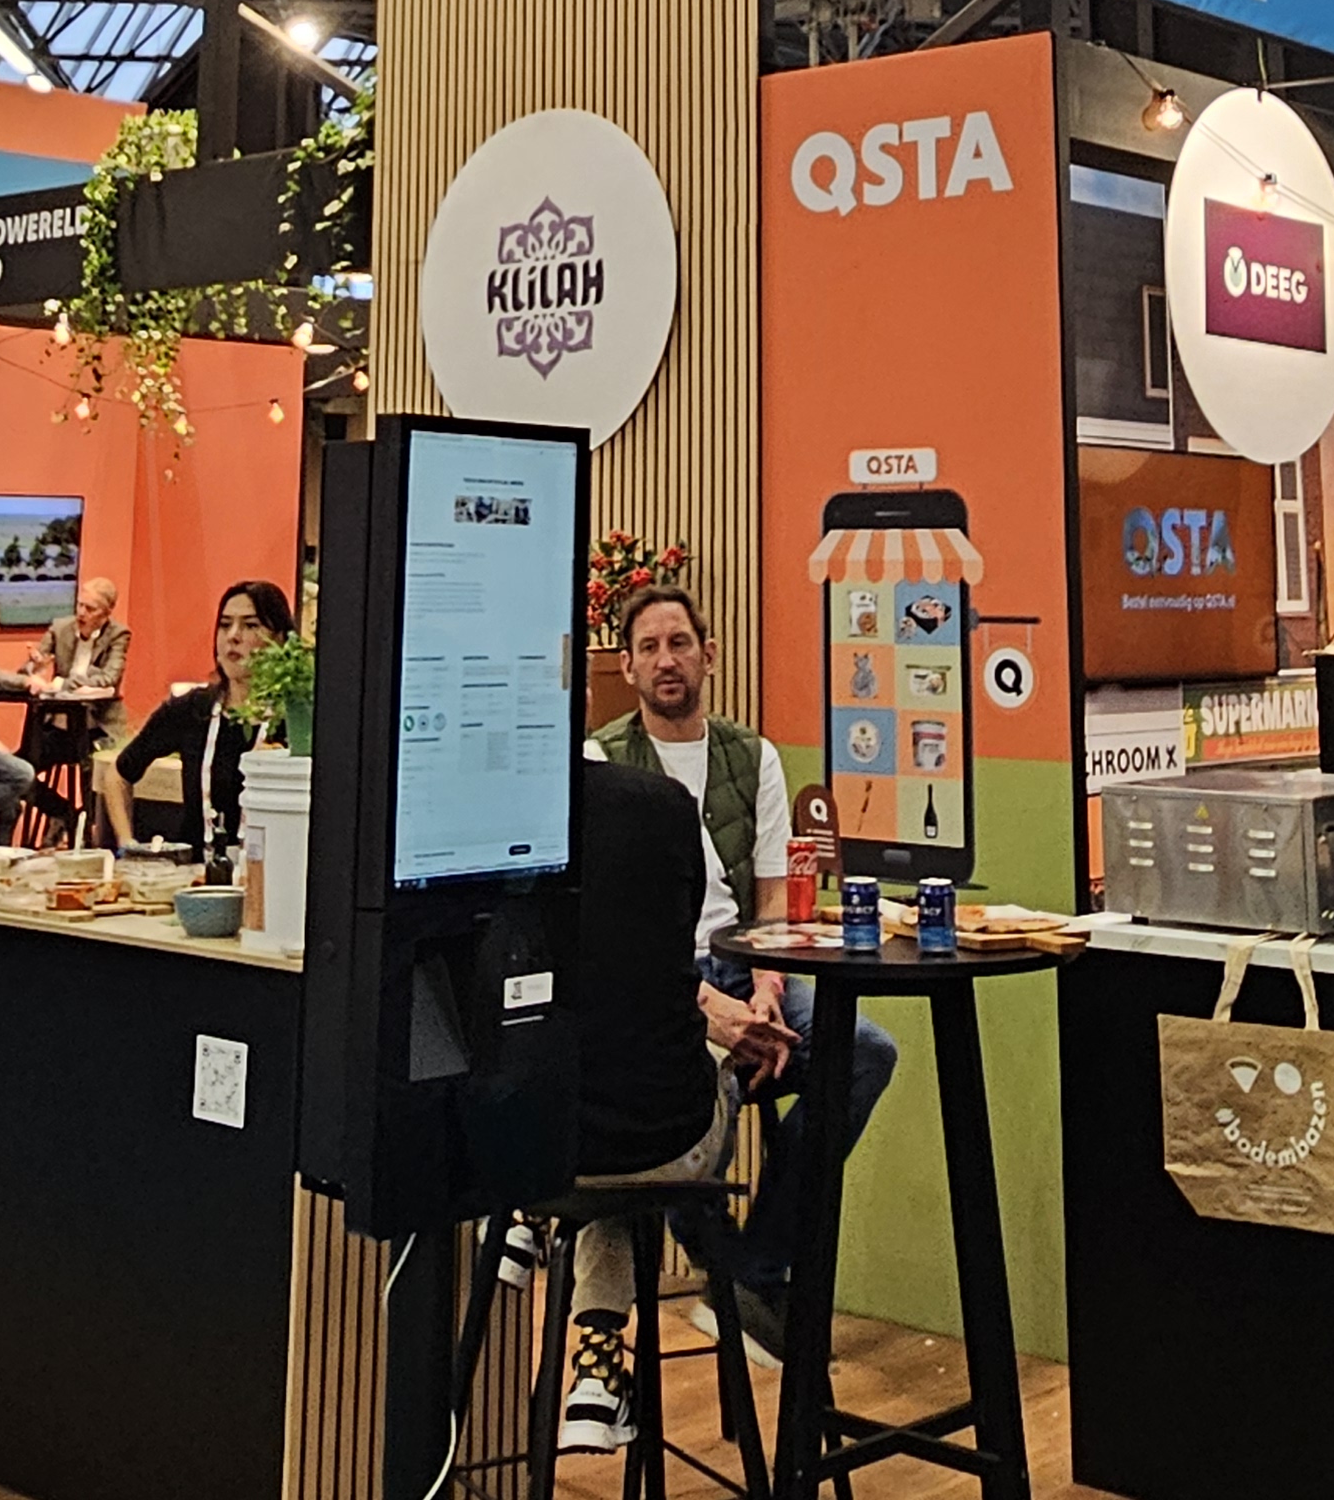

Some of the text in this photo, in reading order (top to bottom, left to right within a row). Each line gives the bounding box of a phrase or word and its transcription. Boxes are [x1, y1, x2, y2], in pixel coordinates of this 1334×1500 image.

[790, 110, 1015, 217] QSTA
[1250, 262, 1309, 305] DEEG
[866, 454, 919, 477] QSTA
[1123, 506, 1236, 577] QSTA
[994, 659, 1024, 697] Q
[1086, 746, 1162, 777] HROOM
[809, 797, 829, 823] Q
